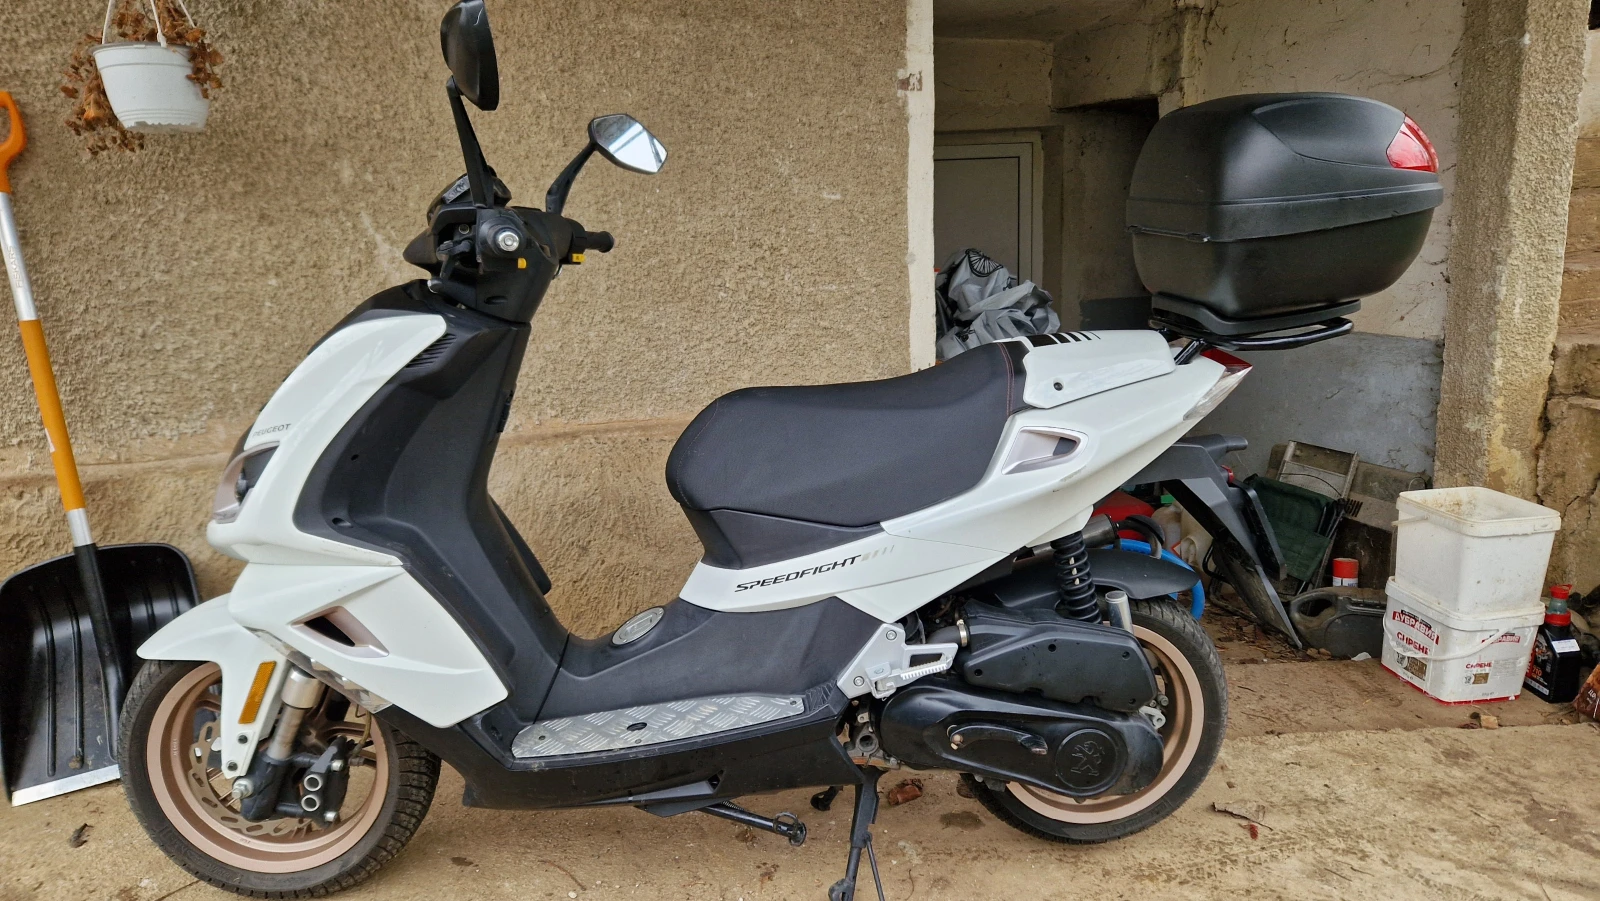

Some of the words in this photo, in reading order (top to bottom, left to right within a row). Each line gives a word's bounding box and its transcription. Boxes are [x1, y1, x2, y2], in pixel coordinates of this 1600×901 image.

[7, 246, 23, 288] FISKARS
[252, 423, 291, 437] PEUGEOT
[735, 554, 861, 592] SPEEDFIGHT
[1395, 612, 1437, 642] ДУБРАВИЯ
